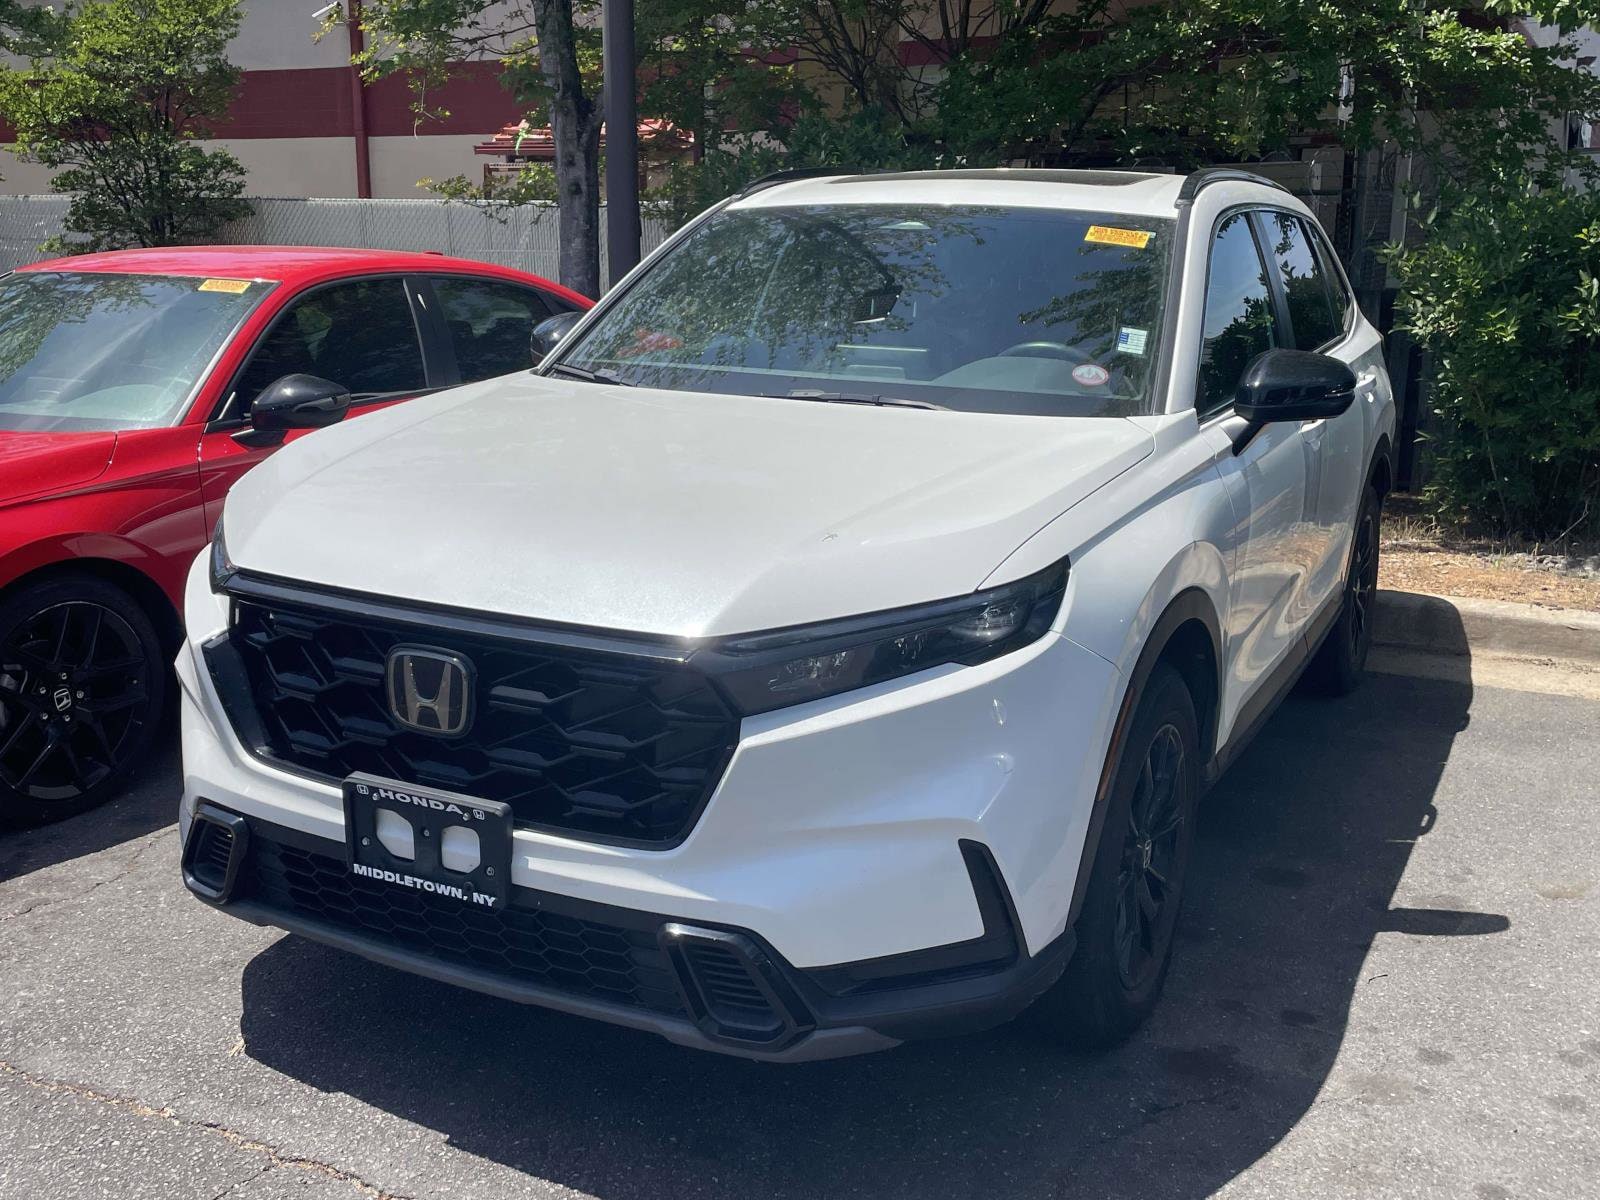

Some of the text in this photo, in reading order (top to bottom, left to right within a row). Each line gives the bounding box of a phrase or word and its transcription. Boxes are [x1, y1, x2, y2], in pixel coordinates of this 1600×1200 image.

[379, 789, 463, 815] HONDA
[353, 864, 496, 907] MIDDLETOWN, NY
